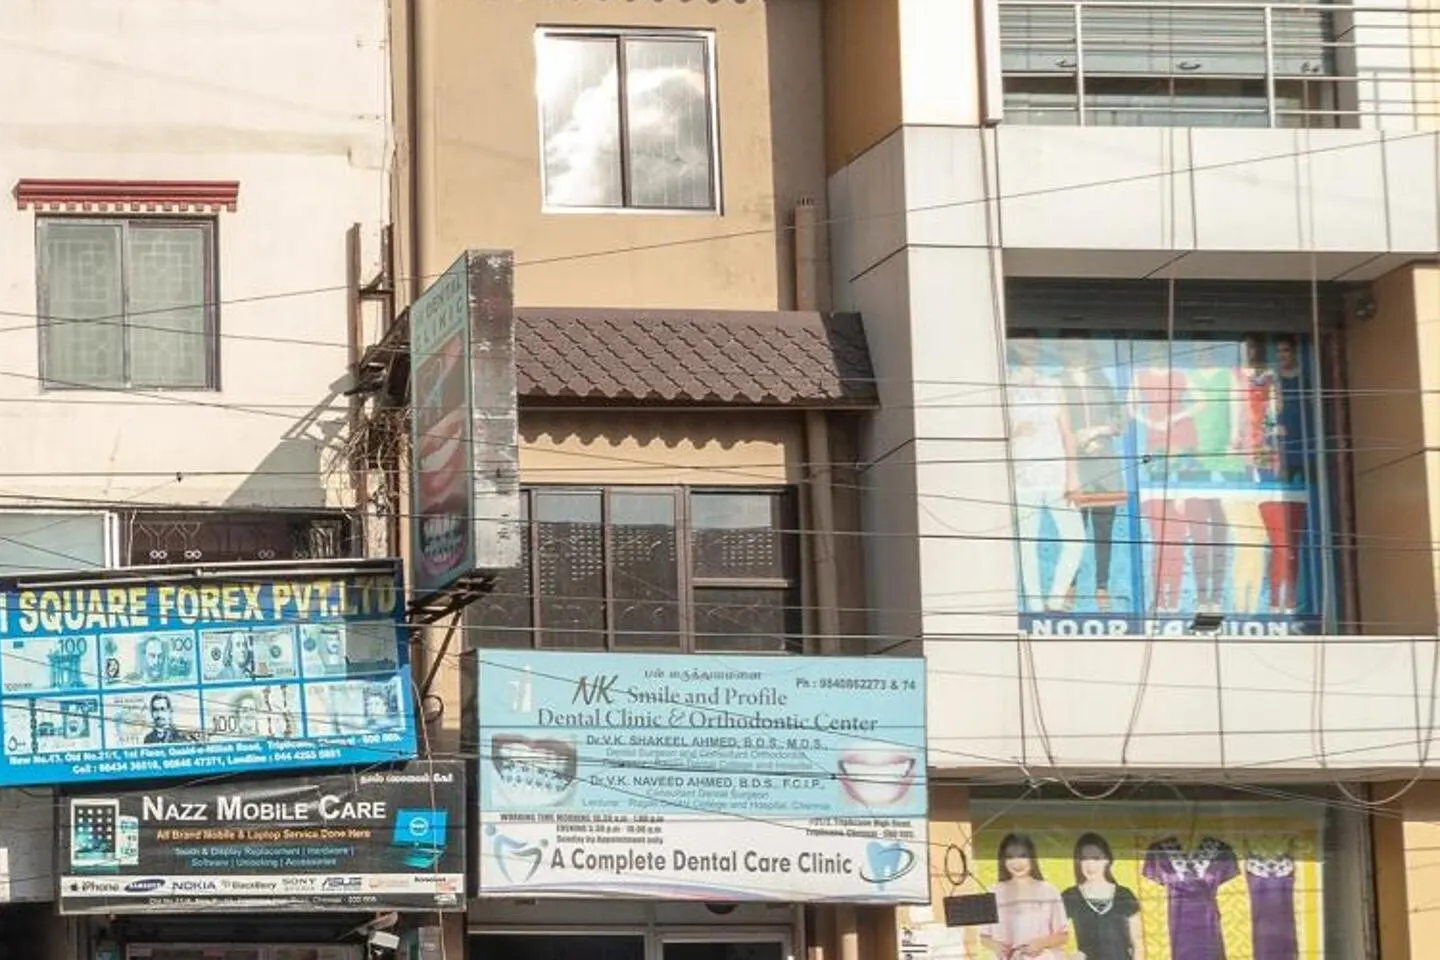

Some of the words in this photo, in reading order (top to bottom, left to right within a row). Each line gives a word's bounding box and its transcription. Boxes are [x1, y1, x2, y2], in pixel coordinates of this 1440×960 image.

[19, 586, 149, 632] SQUARE
[159, 582, 265, 626] FOREX
[1032, 619, 1129, 636] NOOR
[1145, 619, 1306, 636] FAIONS
[572, 675, 618, 705] NK
[627, 686, 682, 704] Smile
[685, 687, 719, 705] and
[724, 688, 788, 706] Profile
[537, 708, 600, 726] Dental
[605, 709, 665, 727] Clinic
[667, 708, 686, 727] &
[688, 710, 810, 730] Orthodontic
[814, 712, 878, 731] Center
[633, 777, 683, 787] NAVEED
[550, 848, 564, 868] A
[570, 848, 666, 874] Complete
[673, 850, 737, 872] Dental
[742, 851, 791, 873] Care
[797, 852, 853, 874] Clinic
[82, 881, 119, 892] iPhone
[172, 882, 217, 890] NOKIA
[282, 877, 316, 885] SONY
